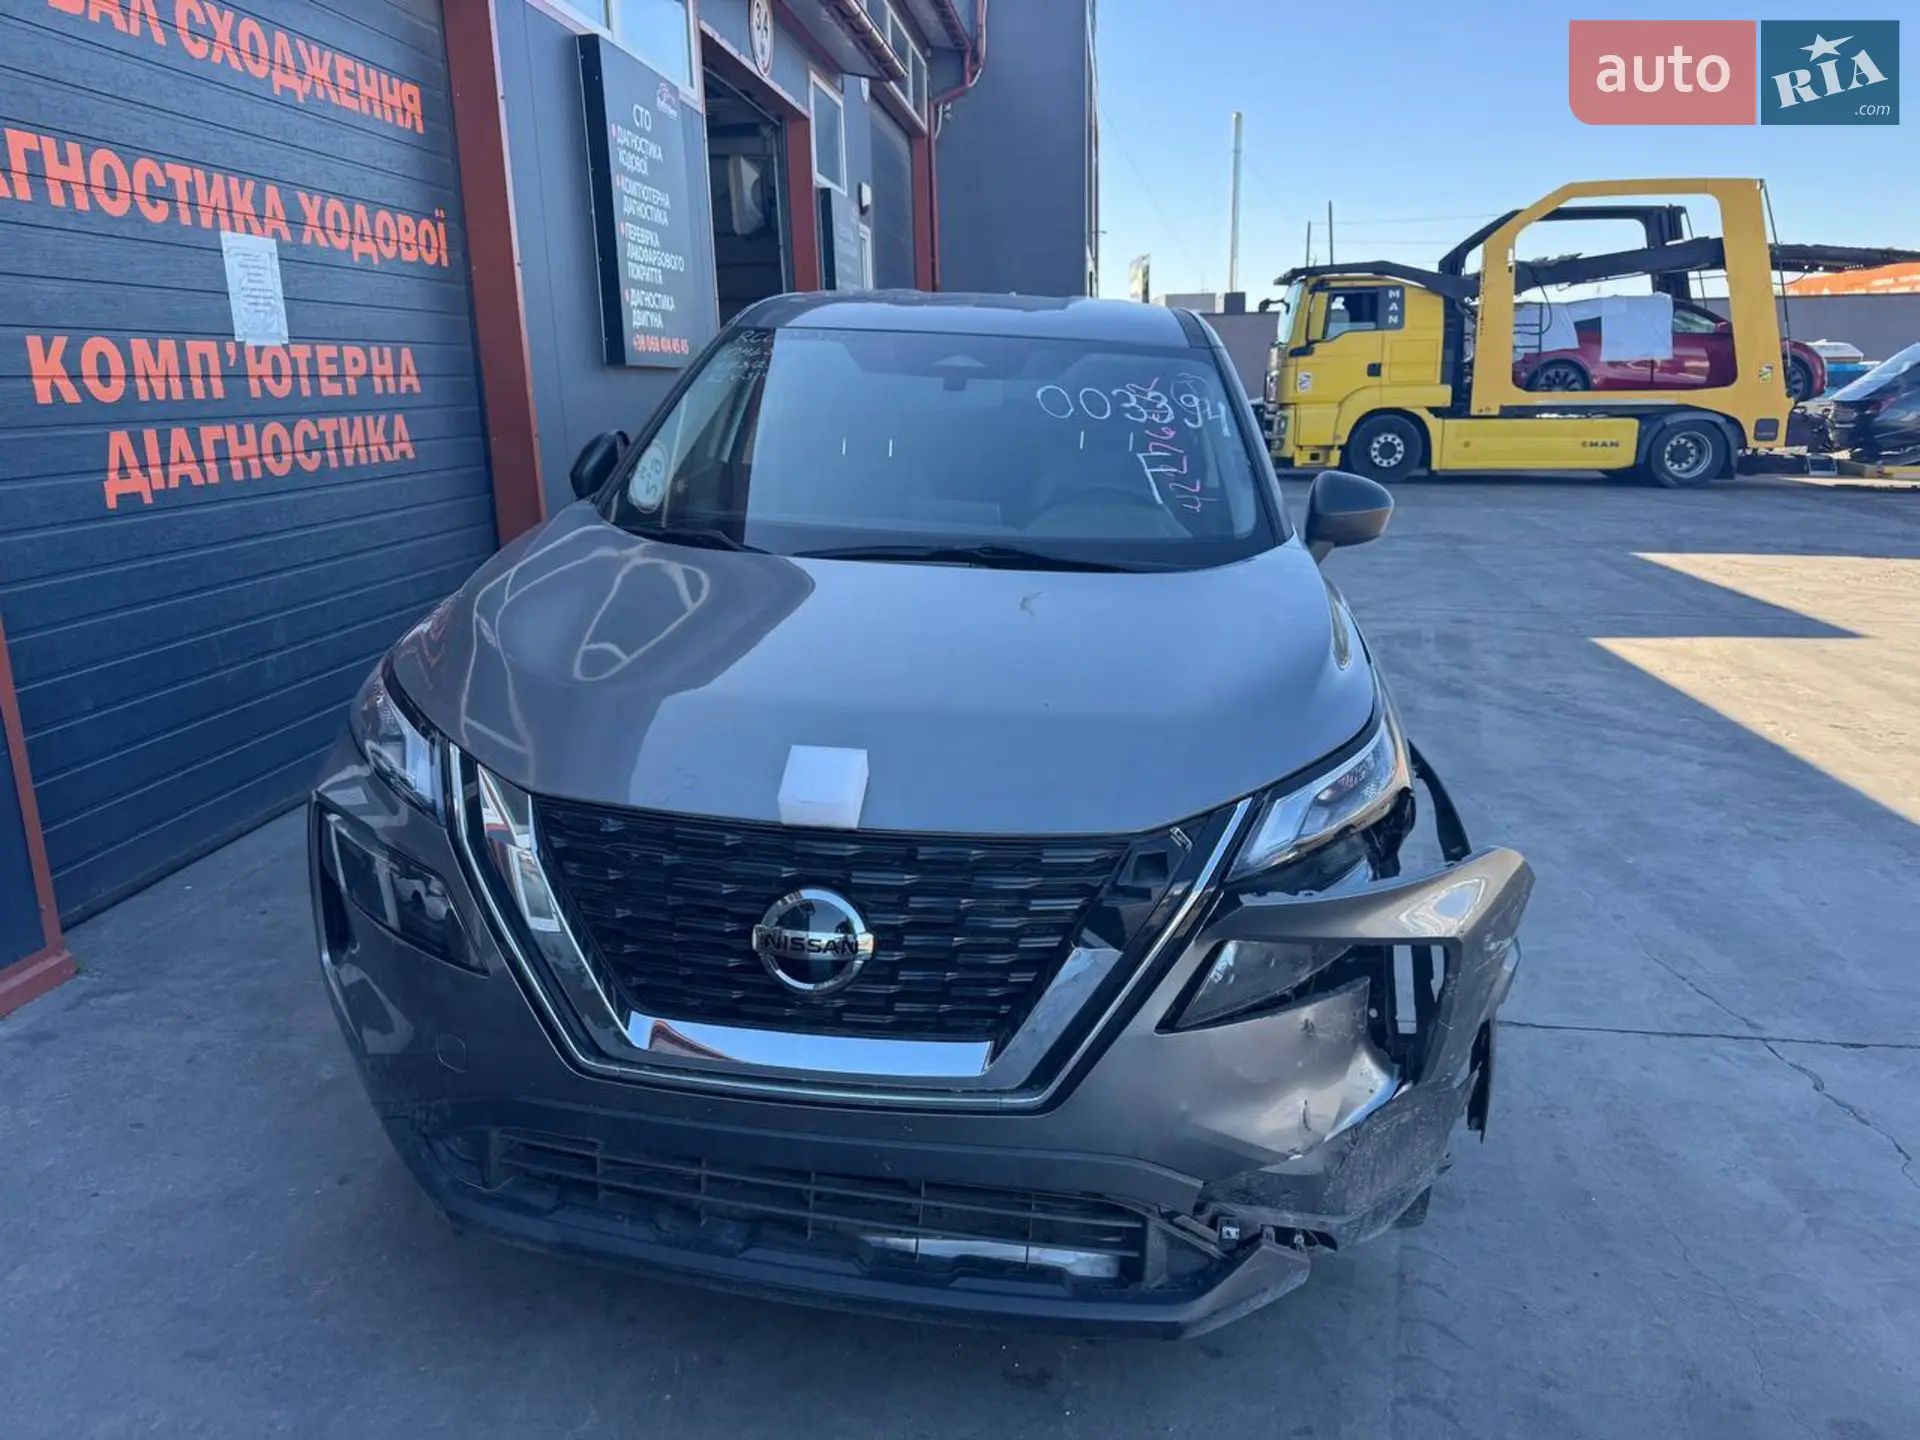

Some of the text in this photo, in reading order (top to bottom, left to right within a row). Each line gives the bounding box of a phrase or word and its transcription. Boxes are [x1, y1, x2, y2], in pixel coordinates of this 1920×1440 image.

[175, 0, 425, 134] СХОДЖЕННЯ
[632, 103, 653, 132] СТО
[0, 128, 450, 267] ГНОСТИКА ХОДОВОЇ
[104, 414, 415, 510] ДІАГНОСТИКА
[765, 935, 859, 955] NISSAN
